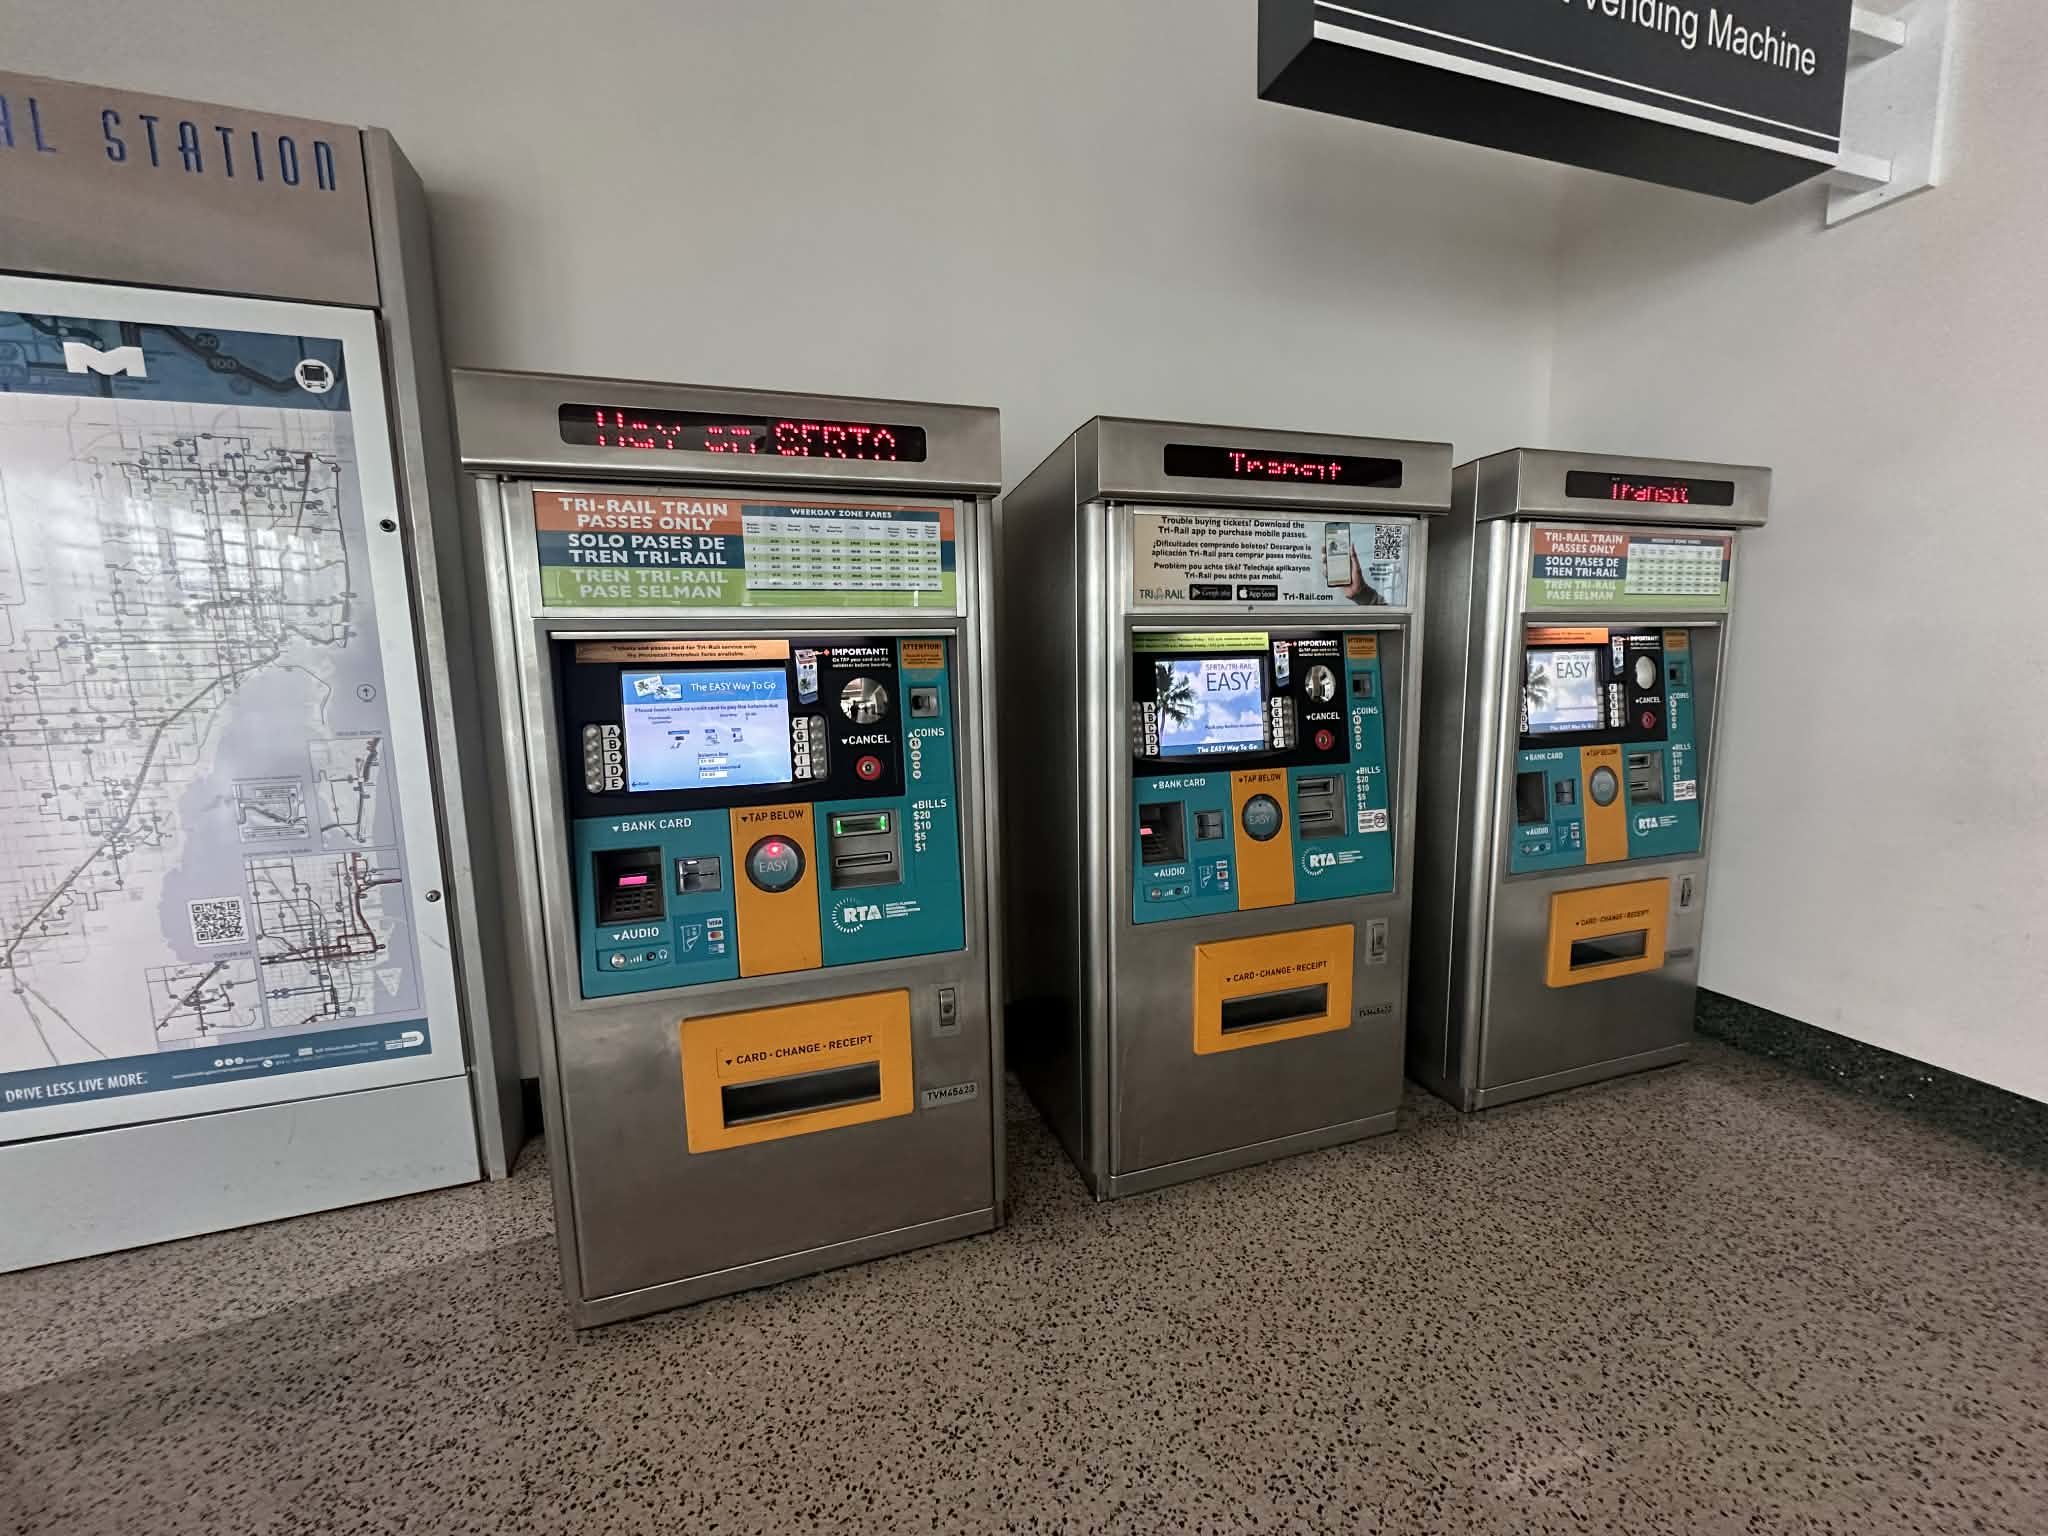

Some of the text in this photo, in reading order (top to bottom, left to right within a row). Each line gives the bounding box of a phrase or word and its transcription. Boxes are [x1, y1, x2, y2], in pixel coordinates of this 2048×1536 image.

[1707, 8, 1816, 76] Machine
[101, 108, 336, 191] STATION
[558, 497, 728, 517] TRI-RAIL TRAIN
[790, 508, 893, 519] WEEKDAY ZONE FARES
[577, 514, 714, 531] PASSES ONLY
[1162, 516, 1192, 525] Trouble
[1195, 518, 1221, 527] buying
[1254, 520, 1290, 529] Download
[1158, 526, 1189, 534] Tri-Rail
[1218, 529, 1252, 537] purchase
[1282, 531, 1307, 539] passes.
[1544, 531, 1623, 544] TRI-RAIL TRAIN
[568, 533, 725, 550] SOLO PASES DE
[1200, 542, 1239, 550] comprando
[1241, 541, 1269, 549] boletos?
[1152, 549, 1187, 557] aplicación
[1552, 543, 1615, 554] PASSES ONLY
[568, 550, 727, 565] TREN TRI-RAIL
[1546, 556, 1619, 567] SOLO PASES DE
[1276, 565, 1310, 573] aplikasyon
[1545, 567, 1618, 577] TREN TRI-RAIL
[571, 570, 728, 584] TREN TRI-RAIL
[580, 585, 721, 598] PASE SELMAN
[1140, 589, 1185, 599] TRI RAIL
[1283, 592, 1333, 600] Tri-Rail.com
[832, 648, 888, 656] IMPORTANT!
[1557, 662, 1590, 678] EASY
[691, 682, 776, 692] The EASY Way To Go
[1207, 672, 1252, 692] EASY
[1356, 706, 1378, 714] COINS
[1311, 712, 1340, 720] CANCEL
[608, 728, 616, 736] A
[914, 728, 945, 737] COINS
[849, 735, 891, 745] CANCEL
[609, 753, 617, 761] C
[611, 766, 619, 774] D
[1360, 766, 1381, 774] BILLS
[1243, 773, 1281, 783] TAP BELOW
[1356, 775, 1369, 784] $20
[612, 779, 619, 788] E
[1159, 778, 1206, 790] BANK CARD
[1357, 784, 1369, 793] $10
[918, 799, 947, 809] BILLS
[1358, 802, 1366, 810] $1
[749, 810, 804, 822] TAP BELOW
[913, 811, 930, 820] $20
[1249, 814, 1271, 824] EASY
[622, 818, 692, 832] BANK CARD
[914, 821, 931, 831] $10
[914, 832, 926, 842] $5
[915, 843, 926, 852] $1
[759, 861, 788, 873] EASY
[1159, 866, 1185, 877] AUDIO
[621, 927, 660, 940] AUDIO
[1234, 960, 1328, 982] CARD CHANGE RECEIPT
[736, 1034, 873, 1065] CARD CHANGE RECEIPT
[5, 1086, 42, 1103] DRIVE
